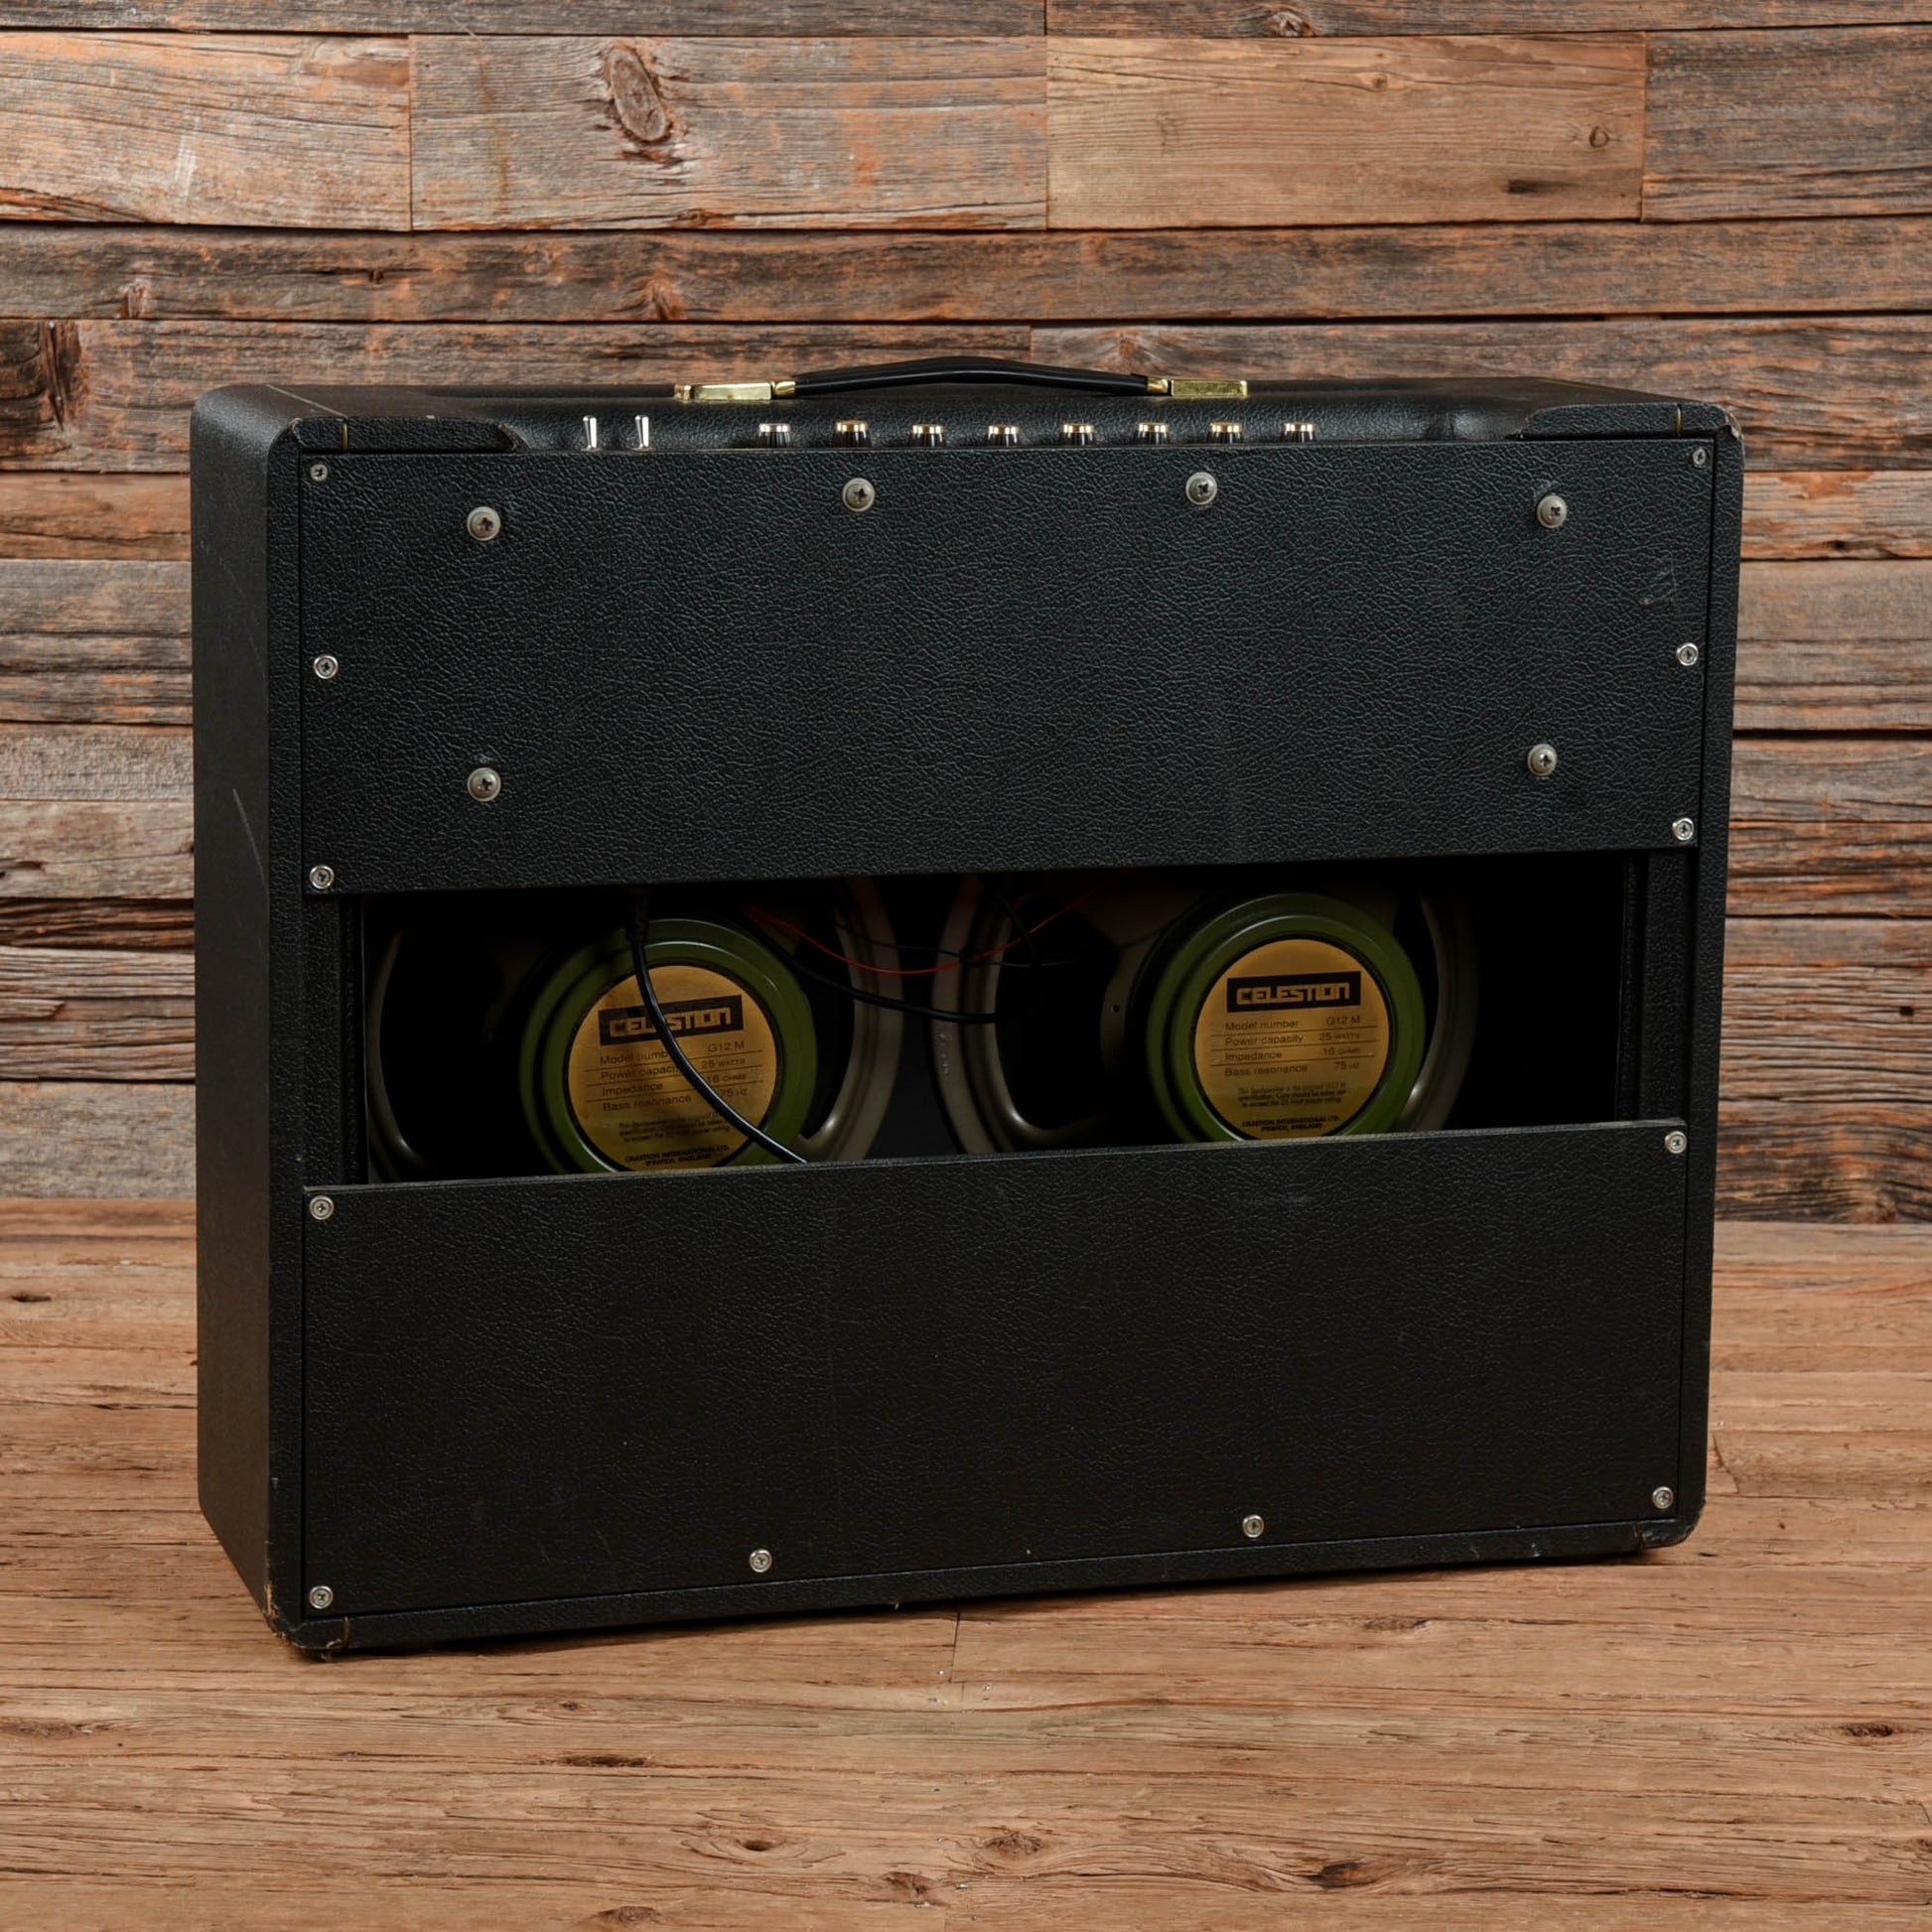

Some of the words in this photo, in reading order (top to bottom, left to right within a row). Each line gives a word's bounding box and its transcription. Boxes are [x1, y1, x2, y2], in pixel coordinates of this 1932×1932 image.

[1236, 982, 1350, 1006] CELESTION
[610, 1007, 731, 1037] CELSTION
[1225, 1021, 1258, 1031] Model
[1261, 1019, 1299, 1029] number
[1326, 1017, 1347, 1026] G12
[1225, 1036, 1258, 1045] Power
[1261, 1034, 1303, 1046] capacity
[601, 1054, 634, 1065] Model
[637, 1050, 670, 1060] numb
[708, 1041, 732, 1052] G12
[735, 1040, 745, 1049] M
[1225, 1051, 1282, 1063] Impedance
[601, 1069, 634, 1080] Power
[701, 1059, 715, 1069] 25
[1225, 1067, 1250, 1076] Bass
[1254, 1063, 1308, 1075] resonance
[602, 1082, 663, 1096] Impedance
[707, 1074, 720, 1084] 16
[604, 1101, 631, 1111] Bass
[633, 1094, 692, 1108] resonance
